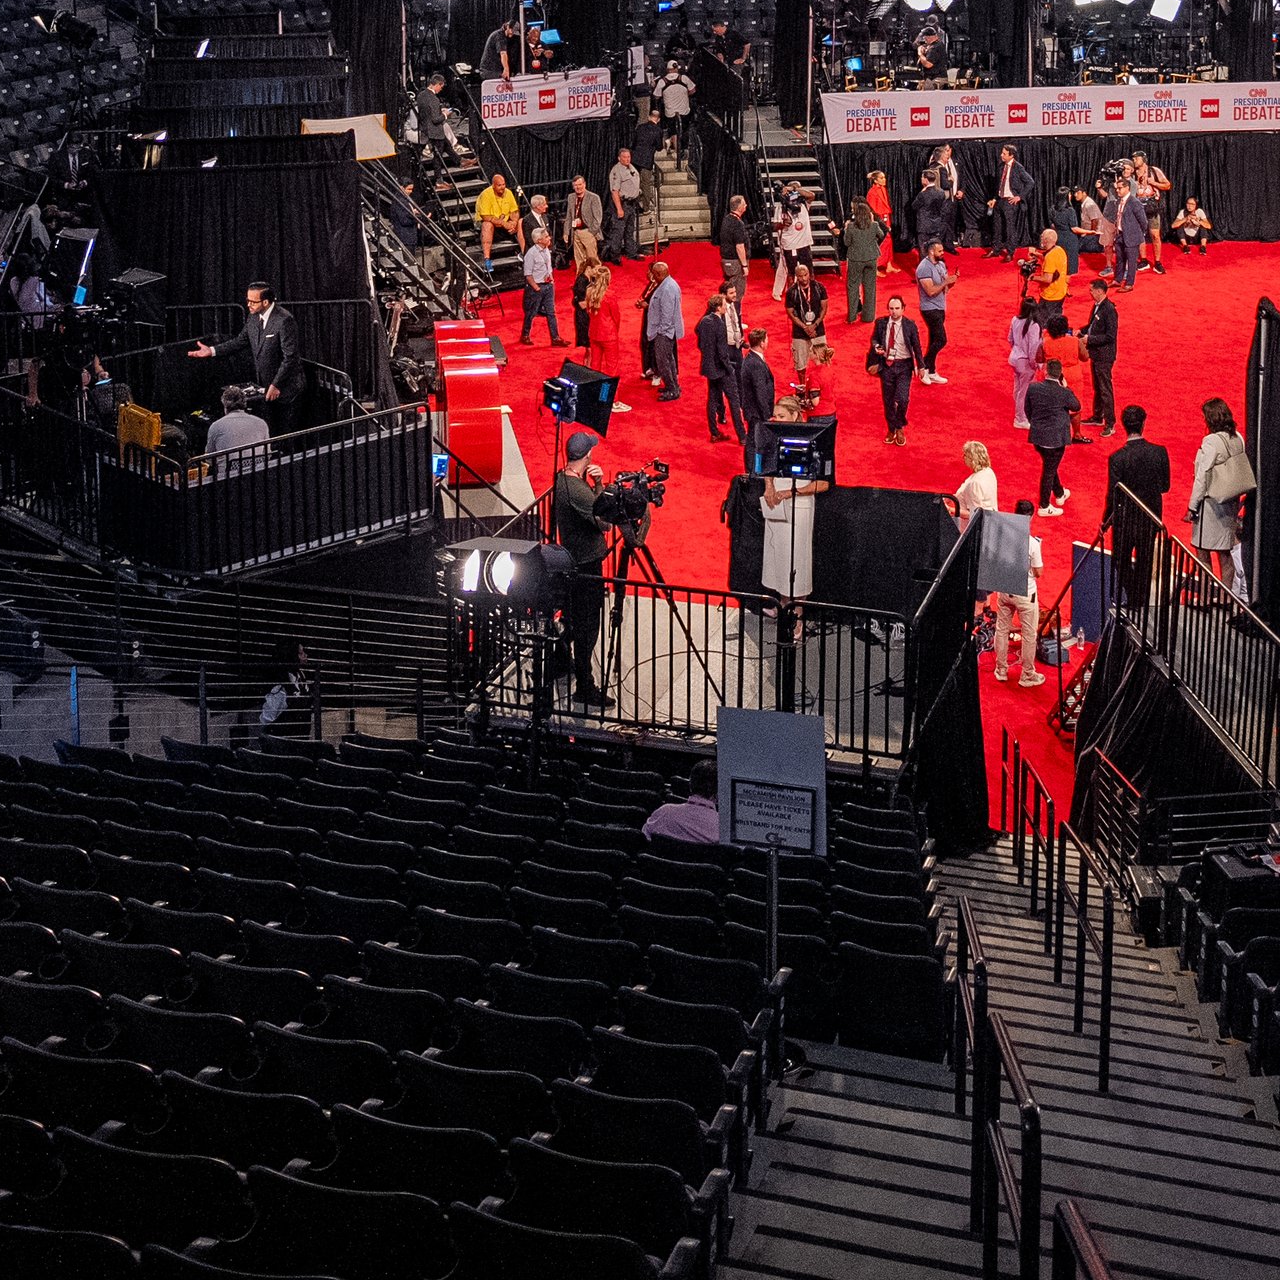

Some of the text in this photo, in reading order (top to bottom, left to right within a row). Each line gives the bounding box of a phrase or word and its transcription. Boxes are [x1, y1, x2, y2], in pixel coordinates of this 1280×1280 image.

[581, 75, 598, 85] CNN
[568, 83, 611, 94] PRESIDENTIAL
[1248, 89, 1267, 98] CNN
[482, 92, 527, 104] PRESIDENTIAL
[568, 92, 611, 111] DEBATE
[960, 96, 980, 105] CNN
[1057, 93, 1077, 102] CNN
[482, 95, 555, 120] CNN DEBATE
[861, 99, 881, 108] CNN
[1042, 101, 1092, 111] PRESIDENTIAL
[846, 108, 897, 118] PRESIDENTIAL
[944, 105, 995, 115] PRESIDENTIAL
[944, 108, 1027, 129] DEBATE CNN
[1042, 106, 1123, 126] DEBATE CNN
[846, 112, 929, 133] DEBATE CNN
